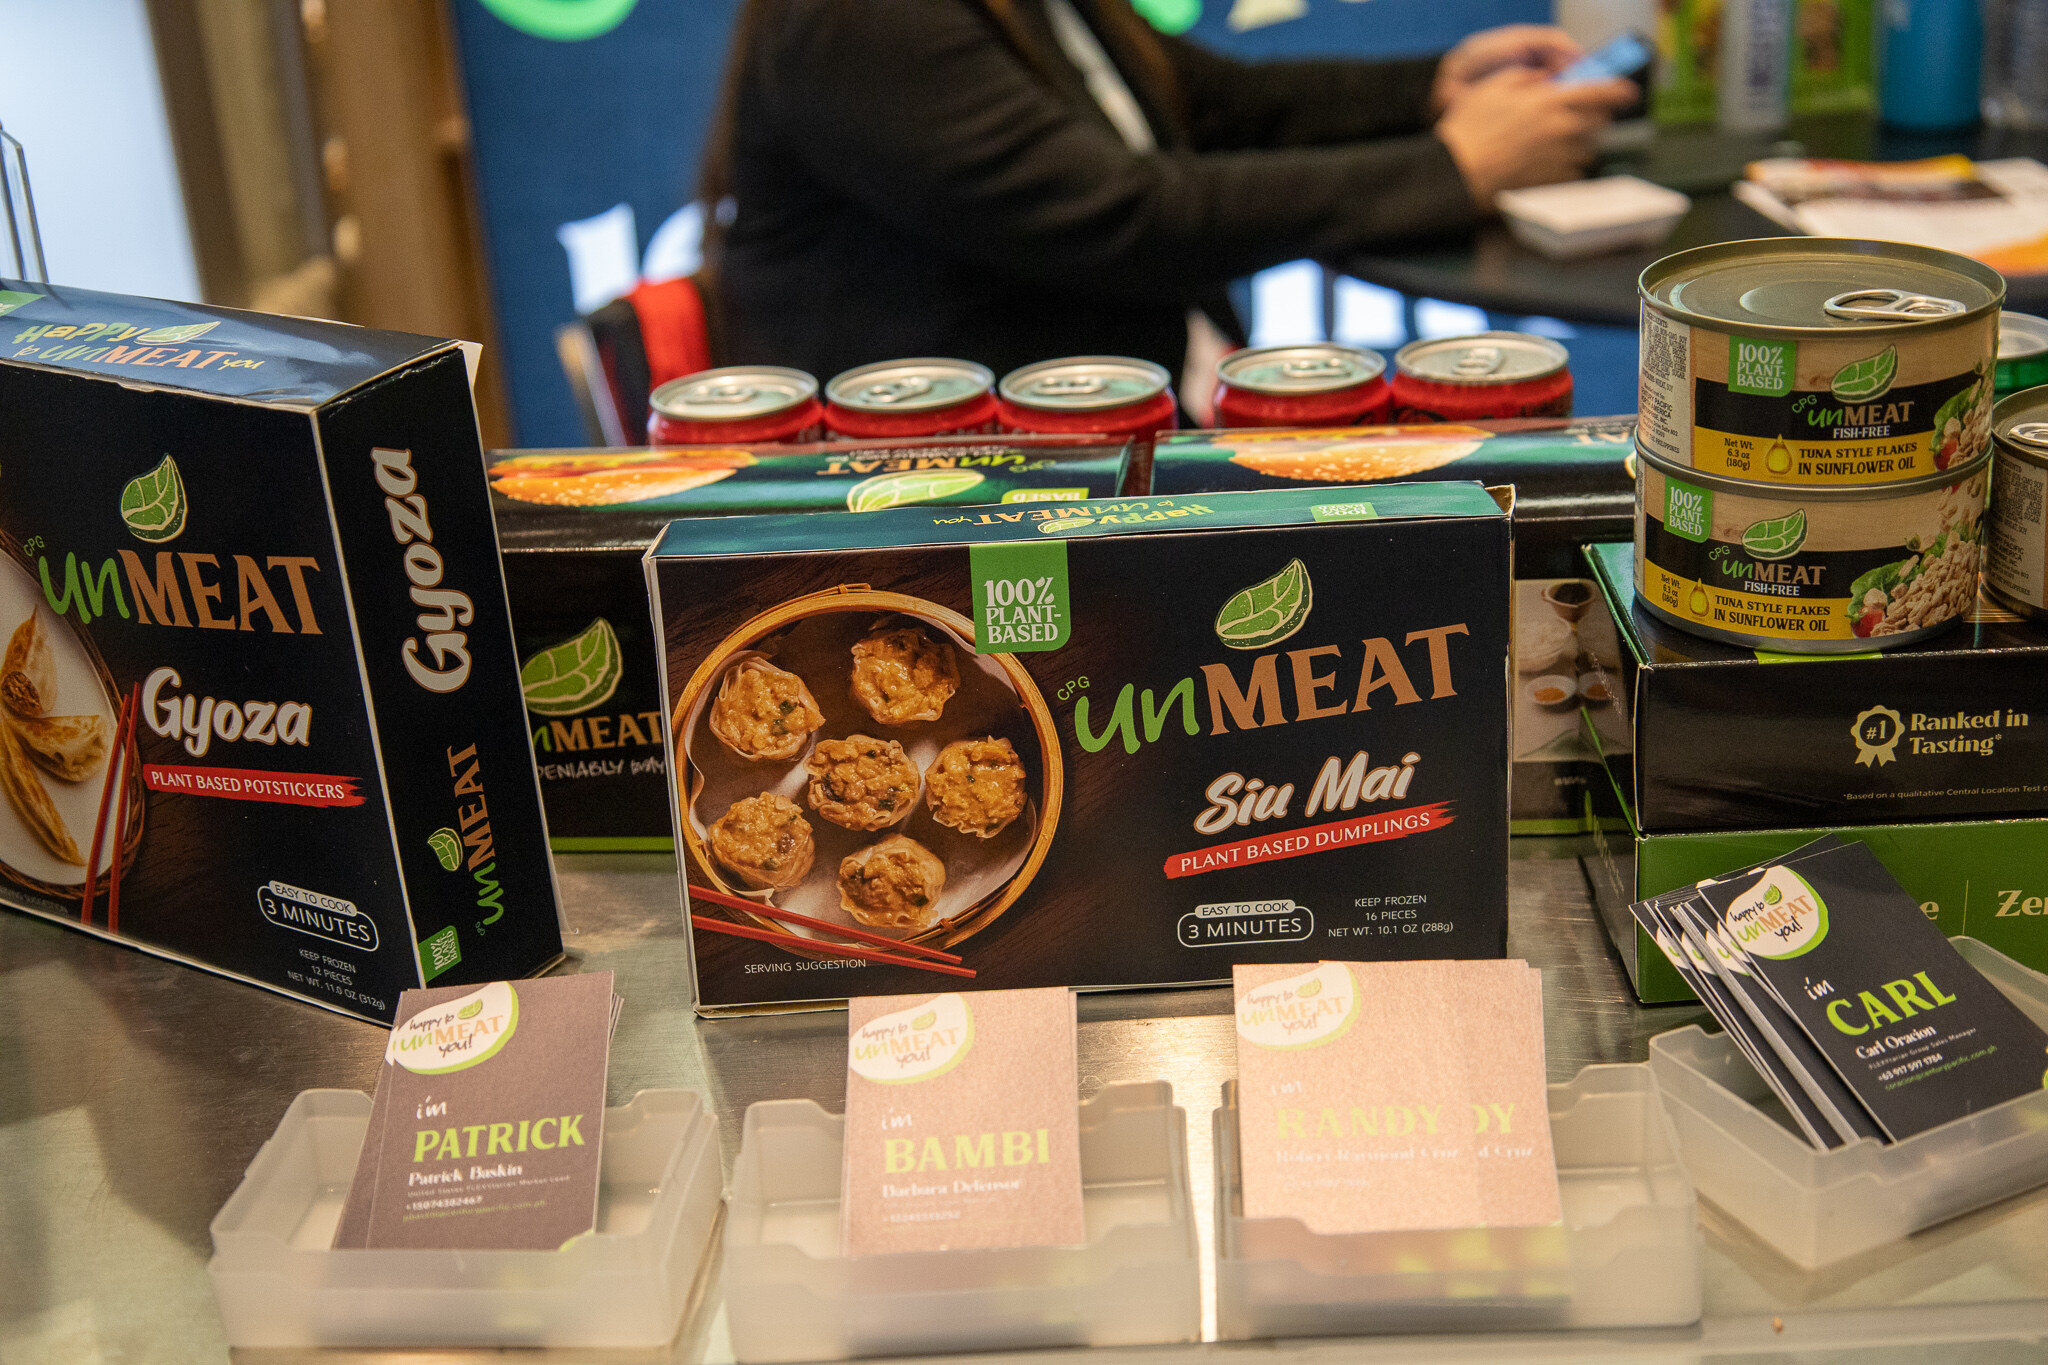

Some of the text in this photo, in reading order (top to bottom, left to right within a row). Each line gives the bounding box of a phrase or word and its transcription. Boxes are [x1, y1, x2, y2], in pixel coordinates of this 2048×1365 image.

[13, 344, 40, 358] to
[218, 358, 265, 371] you
[1738, 343, 1784, 364] 100%
[1737, 361, 1787, 377] PLANT-
[1736, 373, 1784, 390] BASED
[1791, 394, 1818, 414] CPG
[1807, 400, 1915, 428] unMEAT
[1832, 424, 1891, 439] FISH-FREE
[1724, 438, 1754, 451] Net Wt.
[1727, 448, 1751, 460] 6.3 oz
[1799, 441, 1918, 460] TUNA STYLE FLAKES
[1725, 457, 1751, 471] (180g)
[1798, 456, 1916, 476] IN SUNFLOWER OIL
[1671, 486, 1703, 512] 100%
[932, 515, 973, 526] you
[1670, 503, 1705, 524] PLANT-
[1669, 515, 1703, 536] BASED
[22, 534, 46, 558] CPG
[1708, 544, 1731, 562] CPG
[370, 447, 474, 693] Gyoza
[1660, 573, 1681, 588] Net Wt.
[1721, 558, 1827, 586] unMEAT
[38, 548, 324, 635] unMEAT
[984, 577, 1054, 607] 100%
[1662, 584, 1679, 598] 6.3 oz
[1743, 580, 1801, 596] FISH-FREE
[1661, 593, 1680, 609] (180g)
[1714, 594, 1831, 616] TUNA STYLE FLAKES
[985, 605, 1063, 628] PLANT-
[1713, 608, 1830, 632] IN SUNFLOWER OIL
[987, 623, 1059, 645] BASED
[1057, 675, 1091, 702] CPG
[1074, 623, 1471, 755] unMEAT
[142, 666, 312, 757] Gyoza
[1910, 708, 2029, 731] Ranked in
[533, 711, 664, 752] nMEAT
[1866, 719, 1887, 740] #1
[151, 771, 345, 800] PLANT BASED POTSTICKERS
[1193, 750, 1422, 834] Siu Mai
[1897, 789, 1945, 799] qualitative
[1946, 787, 1979, 796] Central
[1981, 785, 2020, 794] Location
[2022, 785, 2041, 793] Test
[446, 742, 504, 925] unMEAT
[1180, 811, 1431, 873] PLANT BASED DUMPLINGS
[274, 884, 352, 914] EASY TO COOK
[1202, 901, 1289, 917] EASY TO COOK
[1354, 894, 1427, 908] KEEP FROZEN
[264, 899, 372, 942] 3 MINUTES
[1365, 909, 1417, 922] 16 PIECES
[1729, 901, 1765, 923] happy to
[1737, 895, 1814, 942] unMEAT
[1187, 917, 1302, 940] 3 MINUTES
[1327, 920, 1454, 938] NET WT. 10.1 OZ (288g)
[1774, 915, 1803, 942] you!
[430, 939, 446, 970] 100%
[447, 931, 458, 961] BASED
[299, 949, 356, 974] KEEP FROZEN
[744, 959, 867, 974] SERVING SUGGESTION
[311, 965, 353, 986] 12 PIECES
[287, 970, 386, 1011] NET WT. 11.0 OZ (312g)
[1247, 989, 1294, 1009] happy to
[1804, 976, 1835, 1000] i'm
[1241, 996, 1346, 1027] unMEAT
[1826, 971, 1957, 1036] CARL
[400, 1015, 503, 1052] unMEAT
[410, 1013, 454, 1033] happy to
[862, 1022, 908, 1041] happy to
[1281, 1013, 1318, 1036] you!
[438, 1034, 473, 1058] you!
[854, 1028, 959, 1061] unMEAT
[1856, 1025, 1937, 1060] Carl Oracion
[1930, 1037, 1948, 1049] Sales
[1949, 1027, 1977, 1043] Manager
[896, 1046, 930, 1068] you!
[1877, 1069, 1894, 1082] +63
[1893, 1064, 1908, 1077] 917
[416, 1095, 447, 1120] i'm
[1276, 1104, 1443, 1140] RANDY
[413, 1114, 585, 1163] PATRICK
[884, 1128, 1050, 1174] BAMBI
[408, 1169, 463, 1187] Patrick
[470, 1164, 523, 1181] Baskin
